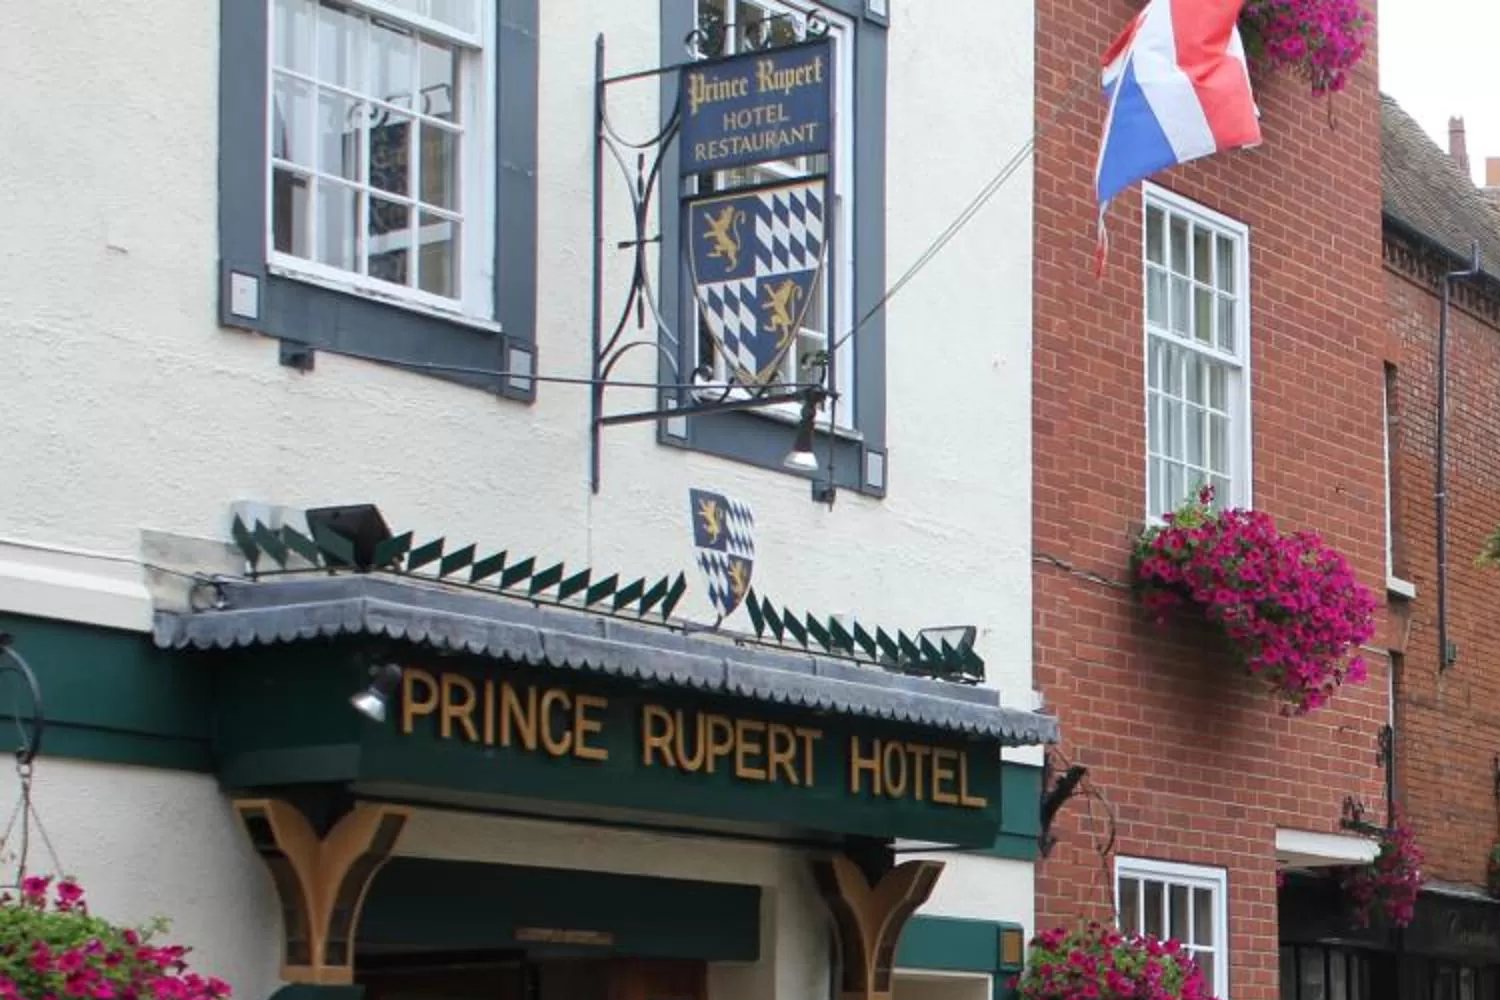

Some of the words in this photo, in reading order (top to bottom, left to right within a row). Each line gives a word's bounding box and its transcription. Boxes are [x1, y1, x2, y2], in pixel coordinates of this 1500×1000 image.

[688, 73, 749, 117] Prince
[757, 56, 824, 96] Rupert
[694, 122, 818, 162] RESTAURANT
[723, 103, 790, 132] HOTEL
[402, 667, 609, 761] PRINCE
[642, 703, 824, 788] RUPERT
[850, 734, 989, 809] HOTEL
